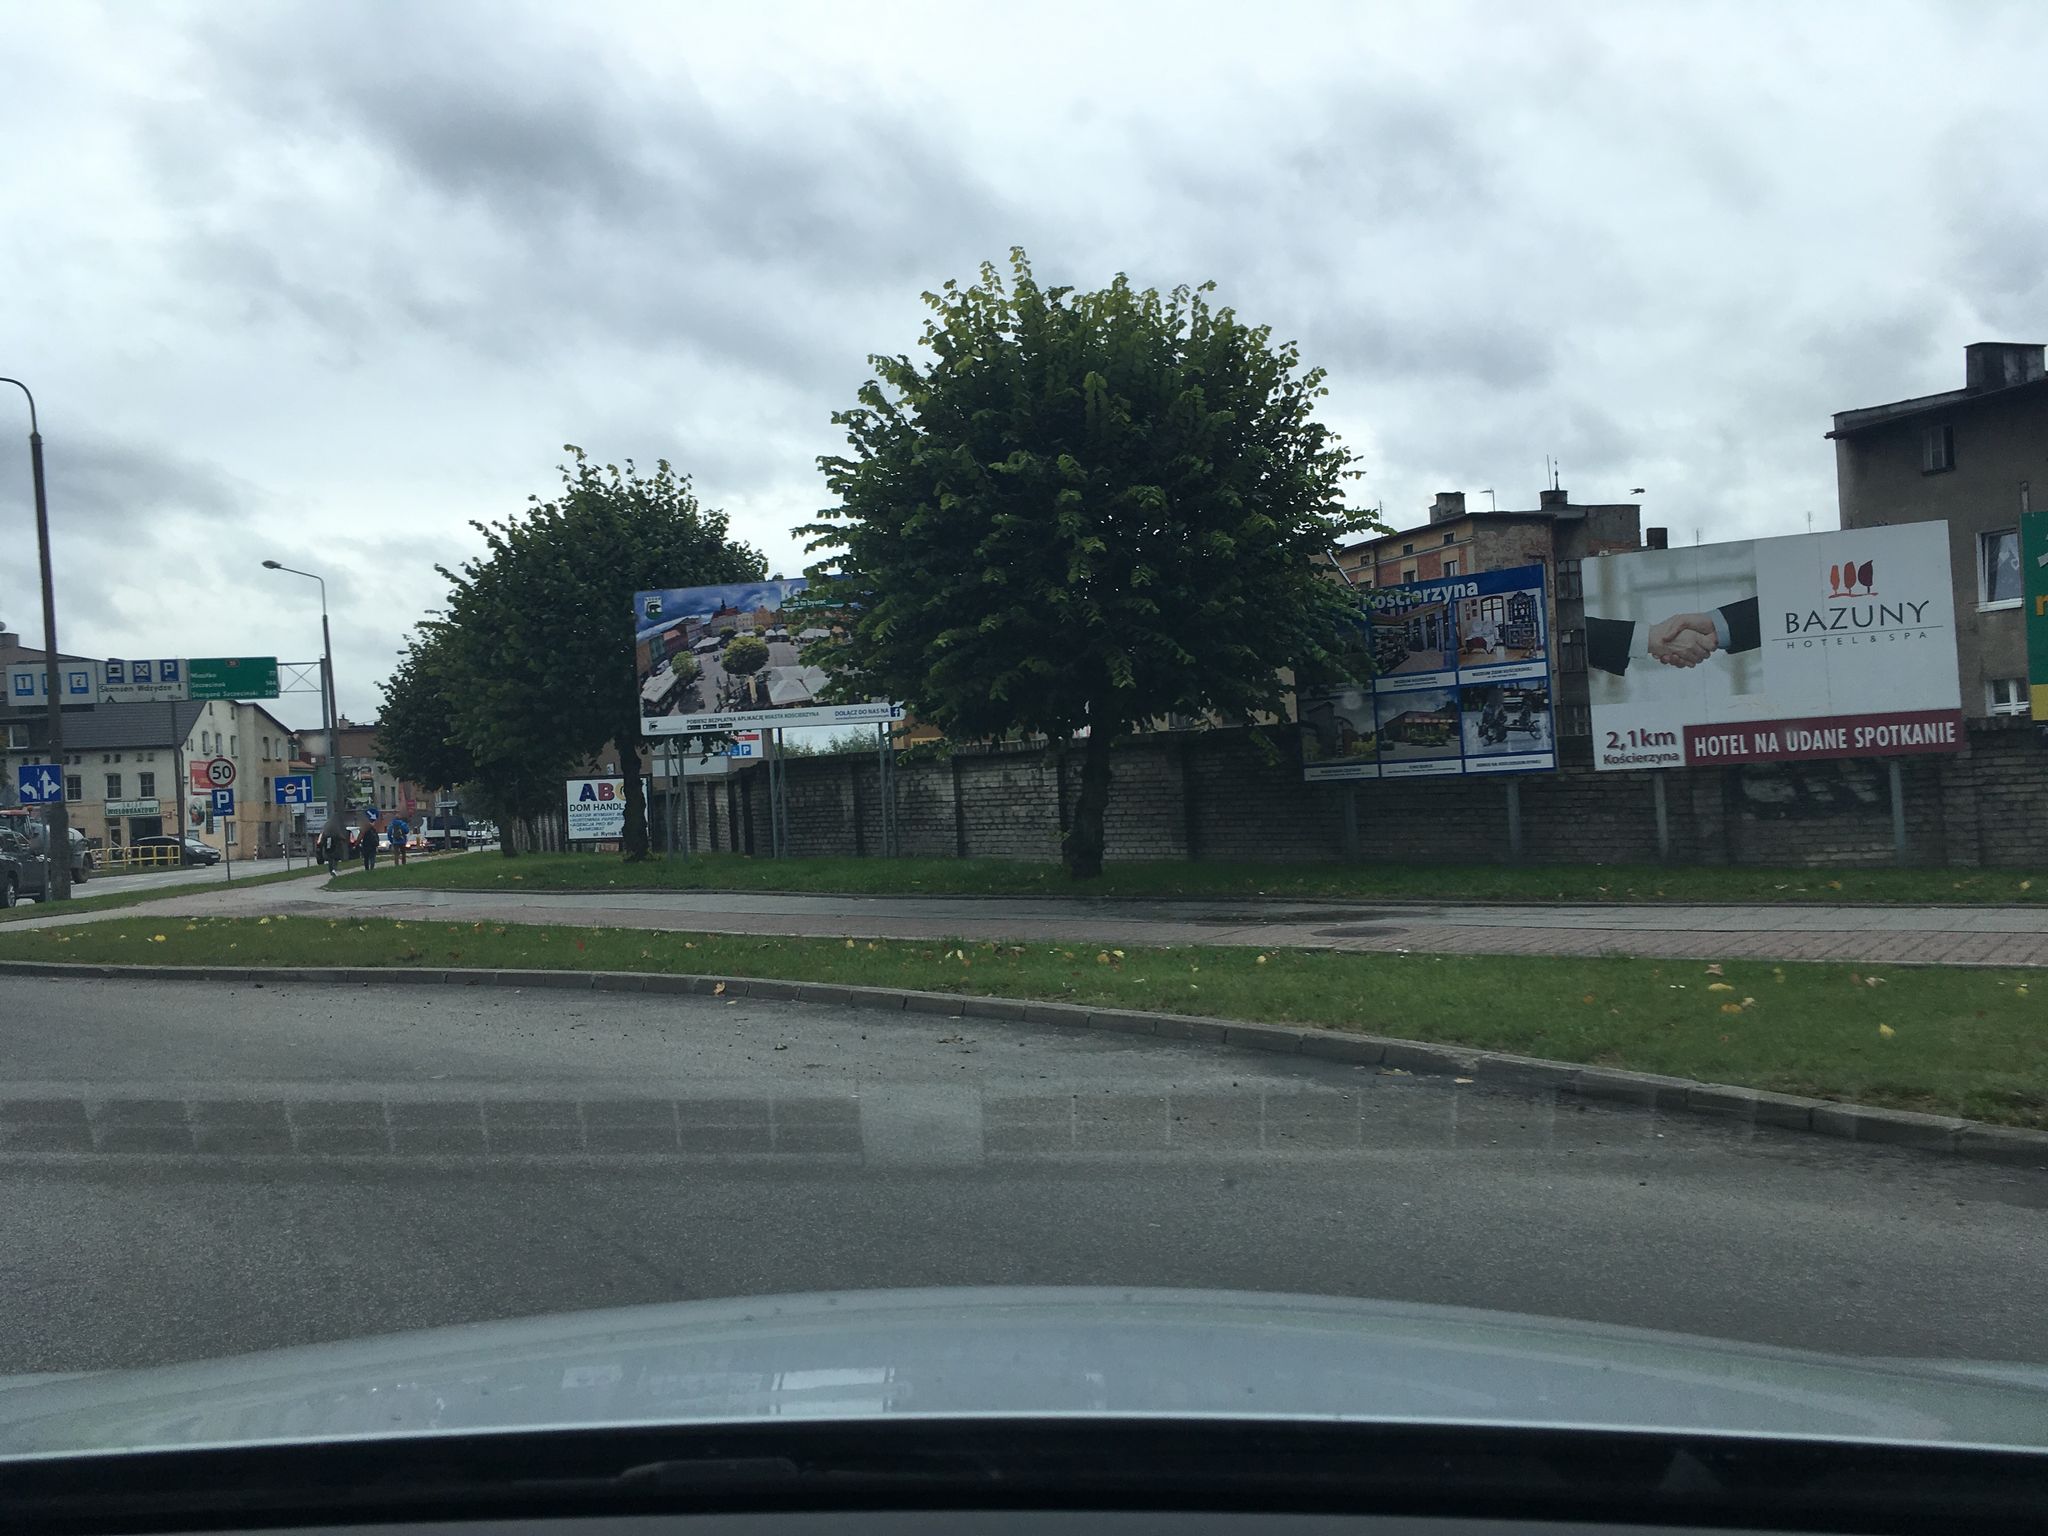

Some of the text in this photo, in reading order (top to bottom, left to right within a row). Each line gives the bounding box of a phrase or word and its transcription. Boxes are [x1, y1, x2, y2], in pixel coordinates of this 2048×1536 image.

[1785, 600, 1930, 634] BAZUNY
[1786, 632, 1928, 649] HOTEL & SPA
[1694, 721, 1956, 757] HOTEL NA UDANE SPOTKANIE
[1603, 751, 1680, 765] Kościerzyna
[212, 765, 232, 780] 50
[569, 802, 625, 812] DOM HANDL
